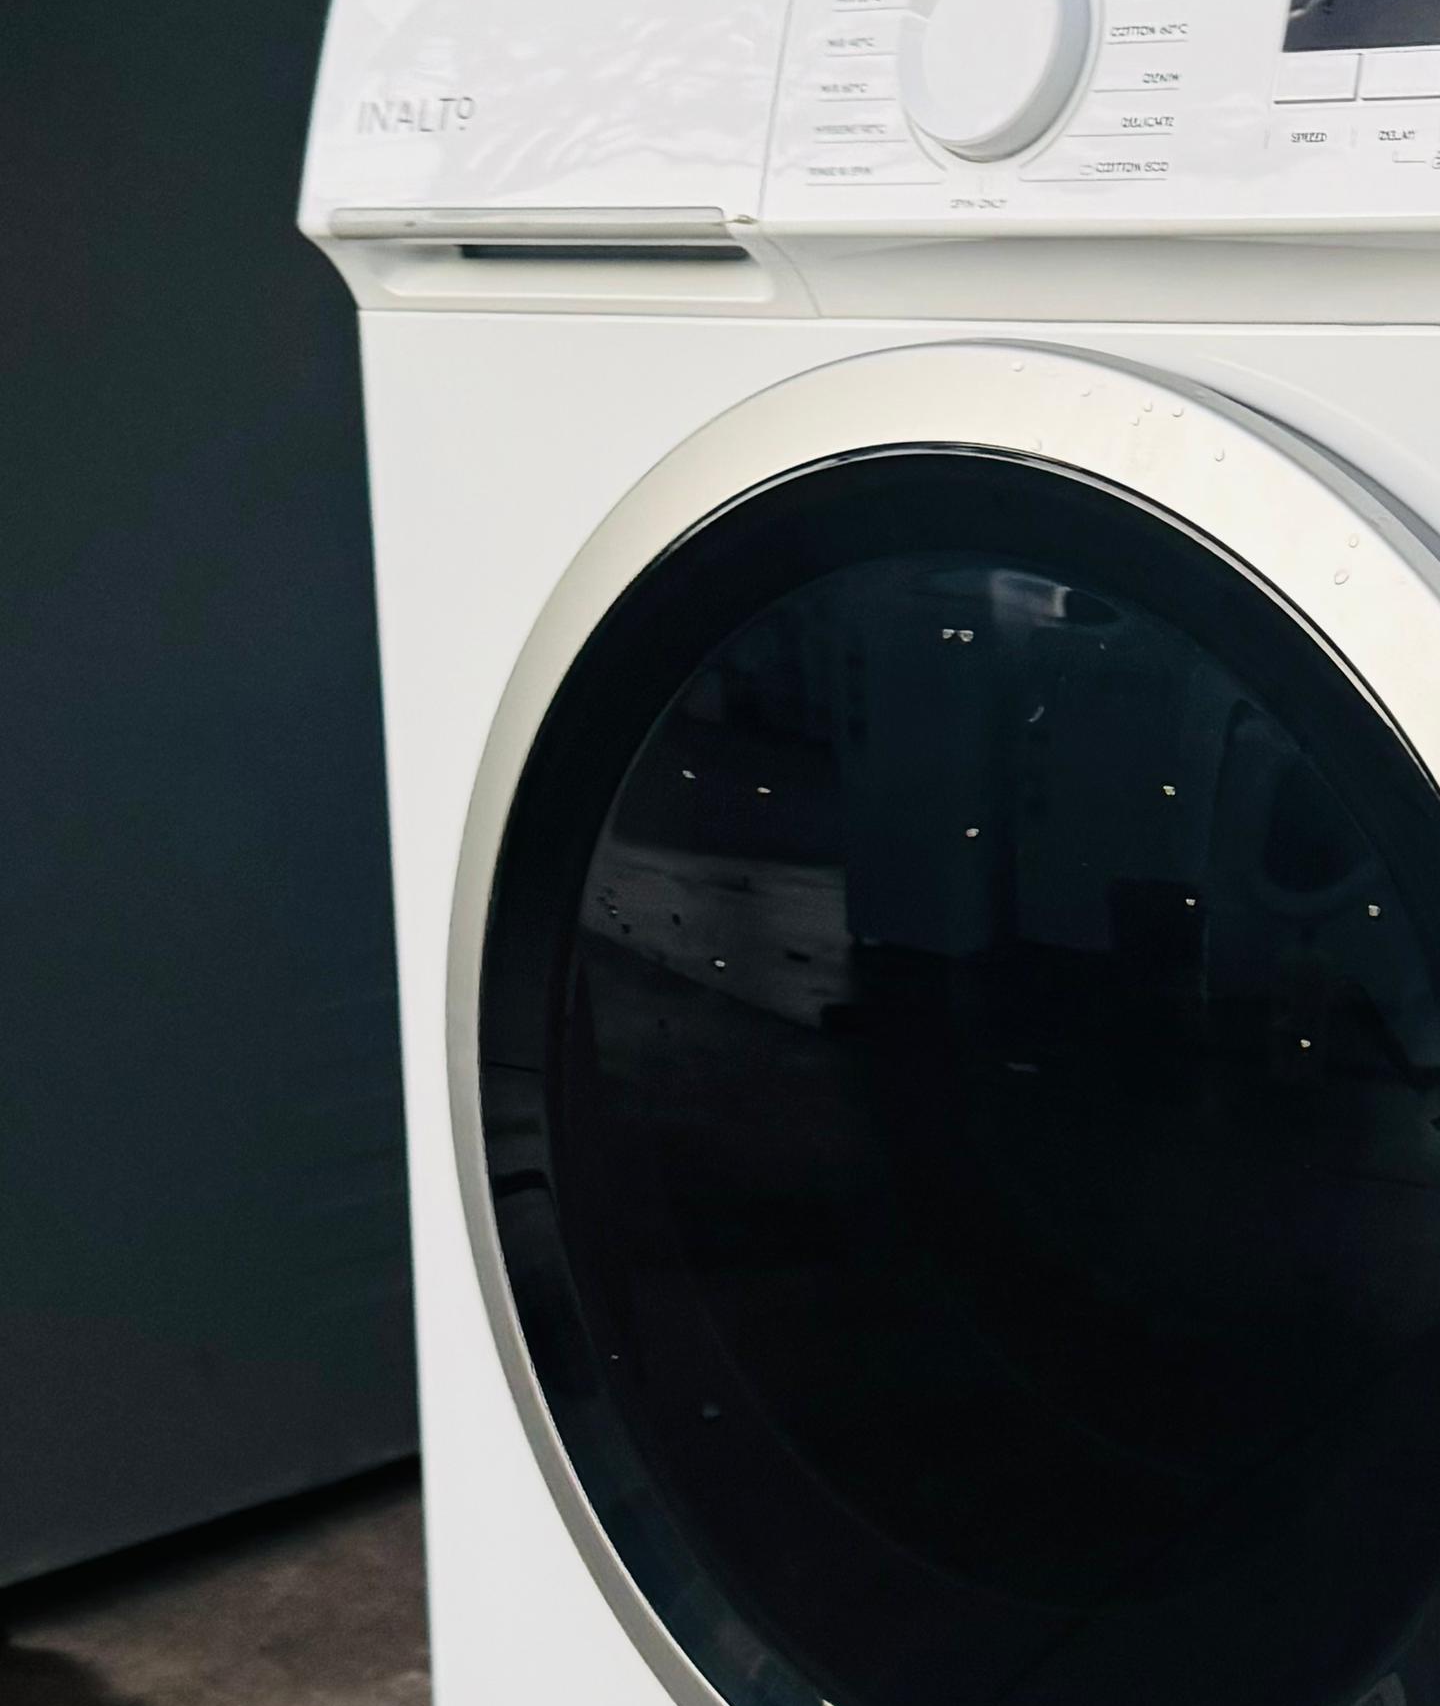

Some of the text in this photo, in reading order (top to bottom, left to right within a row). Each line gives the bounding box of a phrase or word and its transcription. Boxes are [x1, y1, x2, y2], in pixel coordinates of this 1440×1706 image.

[1110, 25, 1156, 38] COTTON
[1121, 116, 1176, 129] DELICATE
[1290, 131, 1328, 143] SPEED
[1378, 129, 1416, 142] DELAY
[1095, 161, 1142, 173] COTTON
